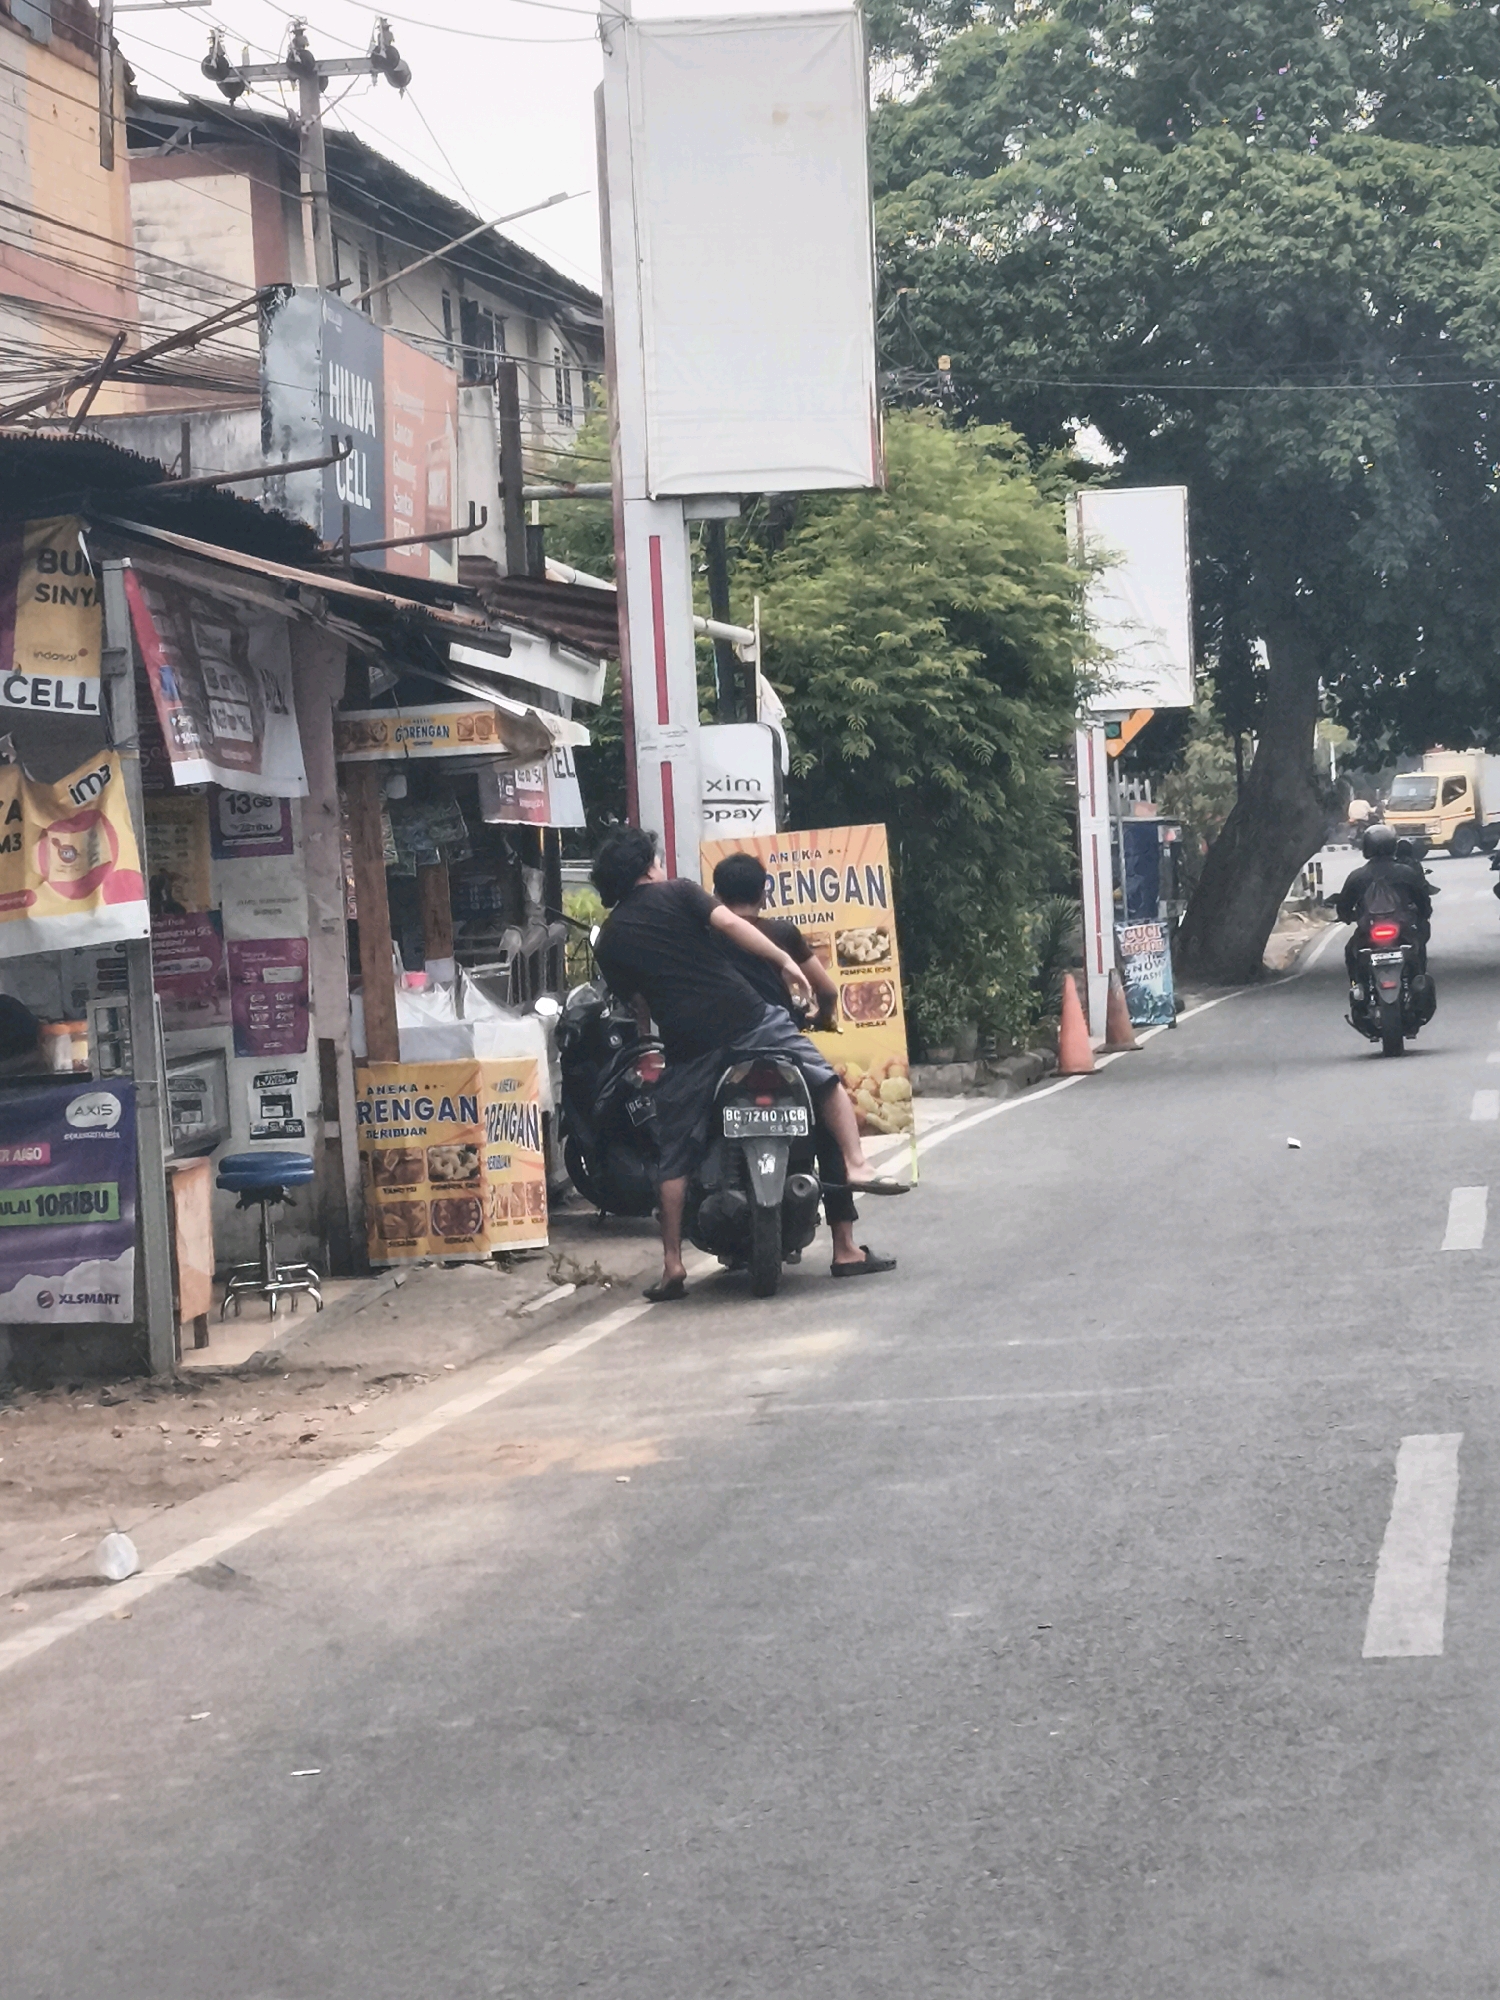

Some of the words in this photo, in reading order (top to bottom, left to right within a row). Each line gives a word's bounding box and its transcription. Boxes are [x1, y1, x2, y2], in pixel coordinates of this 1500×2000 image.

[329, 360, 377, 439] HILWA
[3, 675, 97, 711] CELL
[706, 774, 761, 792] xim
[769, 849, 822, 863] ANEKA
[1124, 925, 1159, 939] CUCI
[367, 1083, 418, 1096] ANEKA
[74, 1103, 114, 1117] AXIS
[58, 1293, 121, 1305] XLSMART
